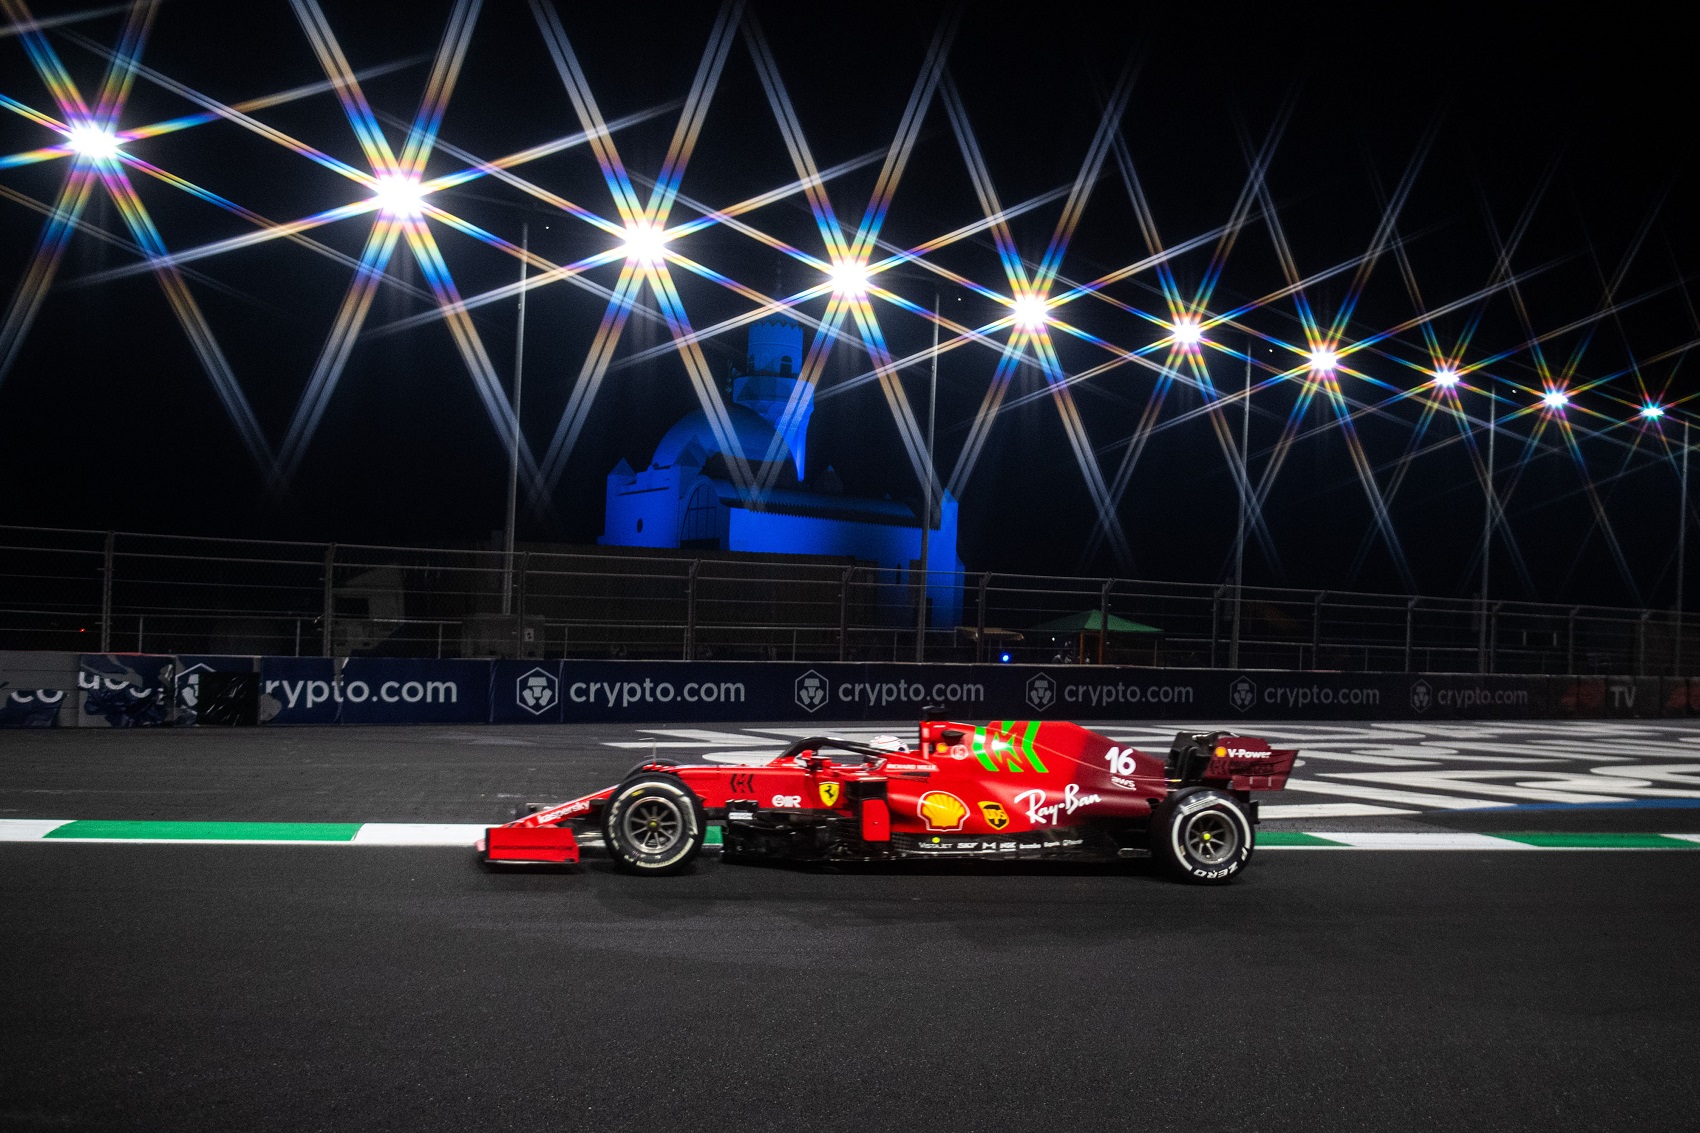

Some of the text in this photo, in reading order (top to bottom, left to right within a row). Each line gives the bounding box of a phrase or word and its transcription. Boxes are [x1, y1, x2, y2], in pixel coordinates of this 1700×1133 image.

[259, 675, 458, 708] rypto.com
[569, 678, 745, 707] crypto.com
[838, 679, 984, 706] crypto.com
[1064, 681, 1194, 707] crypto.com
[1264, 684, 1380, 708] crypto.com
[1437, 686, 1528, 708] crypto.com
[1609, 685, 1637, 708] TV
[1105, 746, 1137, 776] 16
[1227, 748, 1272, 759] V-Power
[1014, 783, 1102, 825] Ray-Ban
[1193, 861, 1239, 879] ZERO
